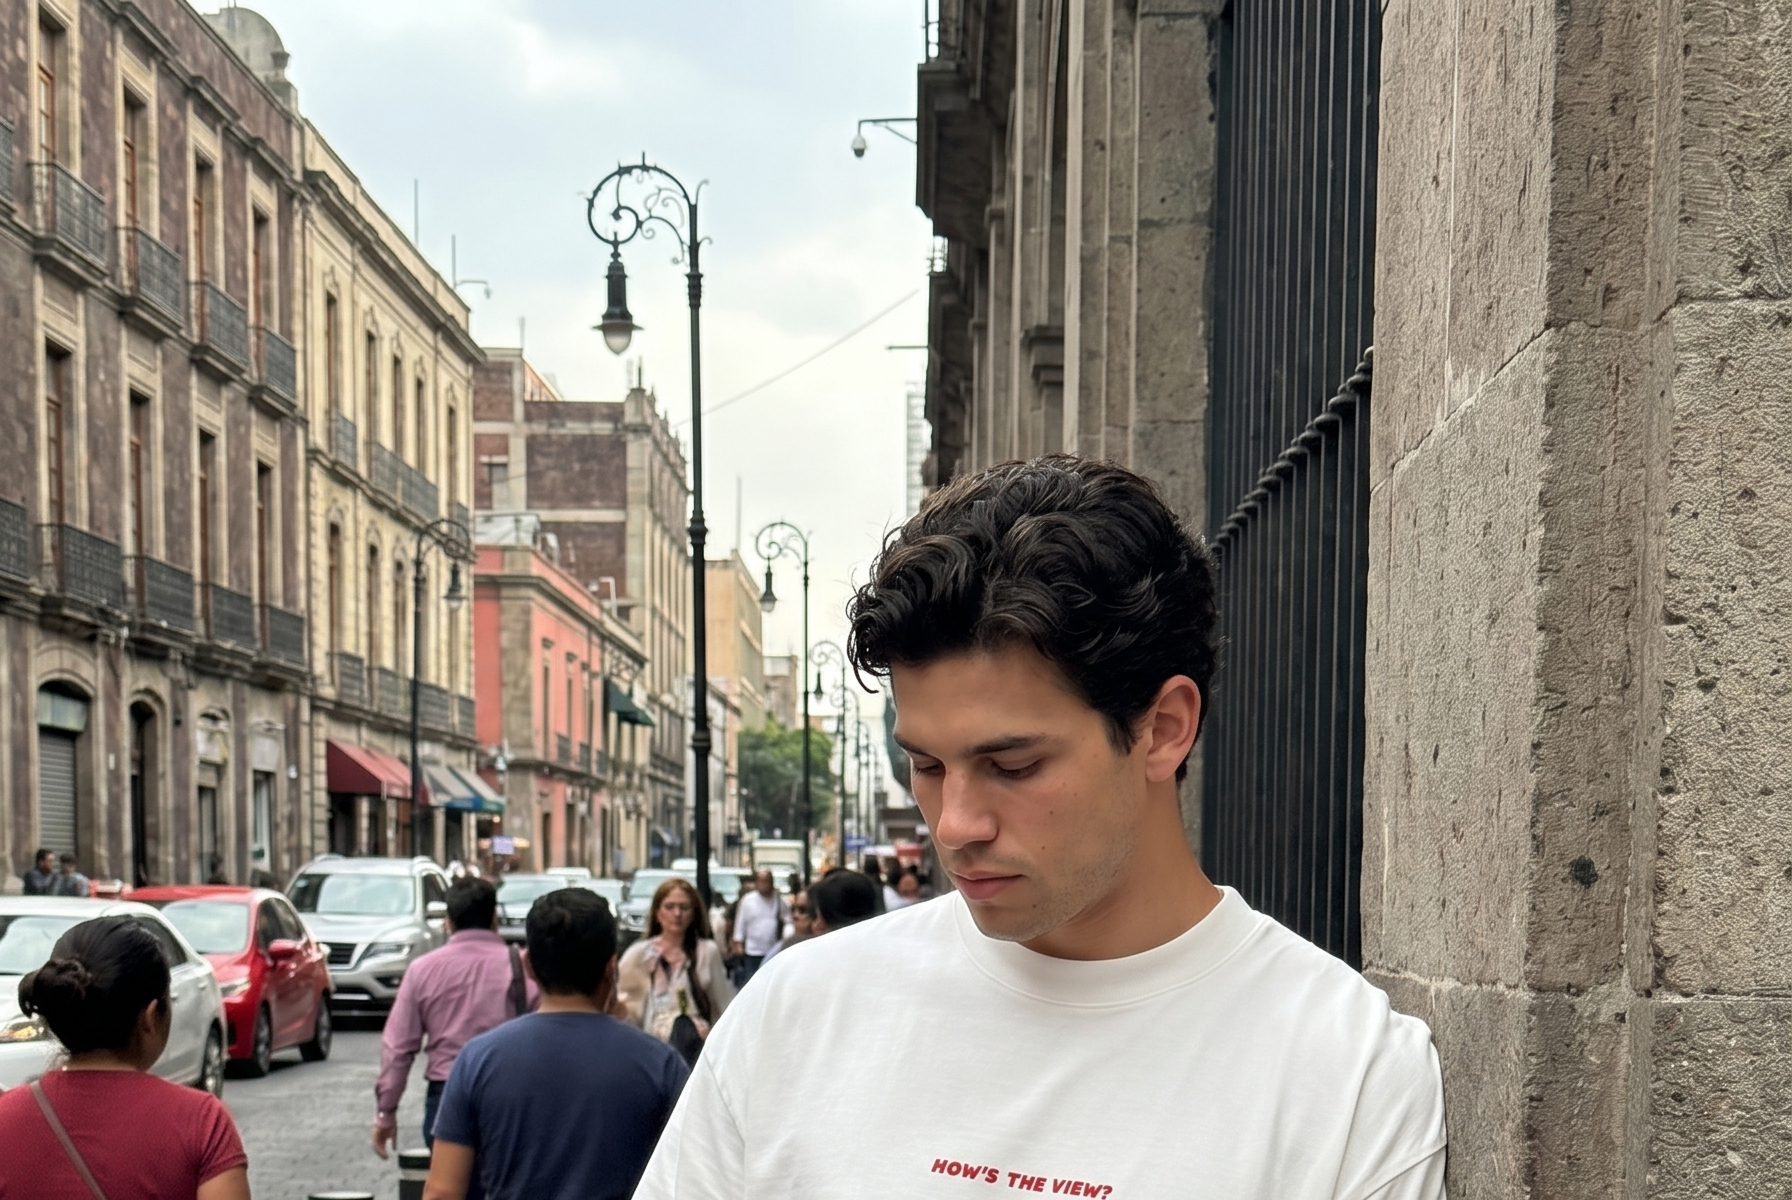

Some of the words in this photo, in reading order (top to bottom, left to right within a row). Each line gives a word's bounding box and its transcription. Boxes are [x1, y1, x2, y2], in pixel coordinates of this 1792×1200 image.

[931, 1159, 999, 1184] HOW'S
[1007, 1172, 1047, 1192] THE
[1051, 1179, 1113, 1200] VIEW?
